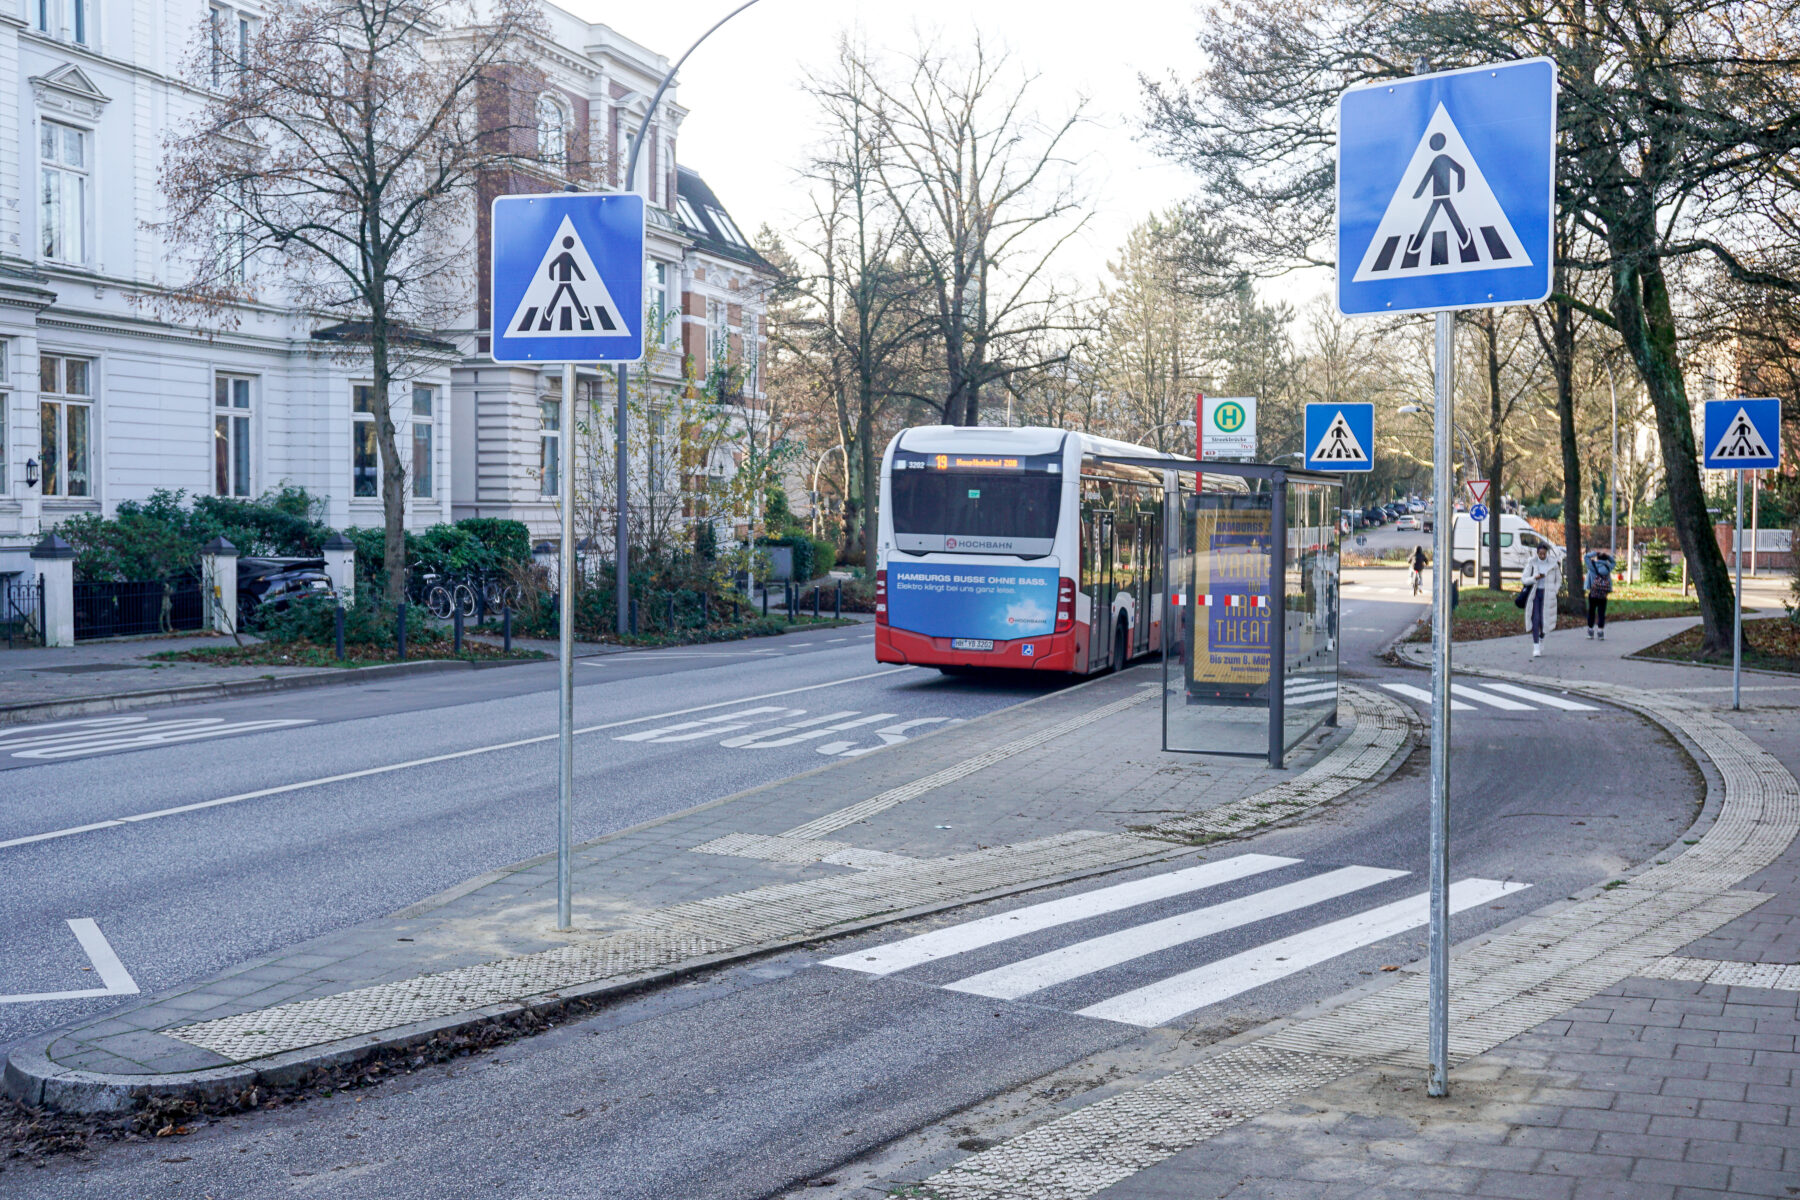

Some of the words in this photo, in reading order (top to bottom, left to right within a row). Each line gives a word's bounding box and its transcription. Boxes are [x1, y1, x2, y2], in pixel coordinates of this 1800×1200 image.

[1222, 408, 1237, 426] H
[908, 461, 926, 469] 3202
[935, 454, 949, 470] 19
[1215, 522, 1263, 533] HAMBURGS
[958, 541, 1013, 549] HOCHBAHN
[897, 573, 952, 583] HAMBURGS
[953, 575, 985, 584] BUSSE
[988, 577, 1016, 585] OHNE
[1018, 577, 1048, 586] BASS.
[896, 582, 923, 591] Elektro
[924, 583, 945, 593] klingt
[946, 584, 958, 592] bei
[975, 587, 995, 595] ganz
[1248, 580, 1261, 593] IM
[1210, 655, 1222, 664] Bis
[1223, 656, 1241, 665] zum
[611, 706, 967, 757] BUS
